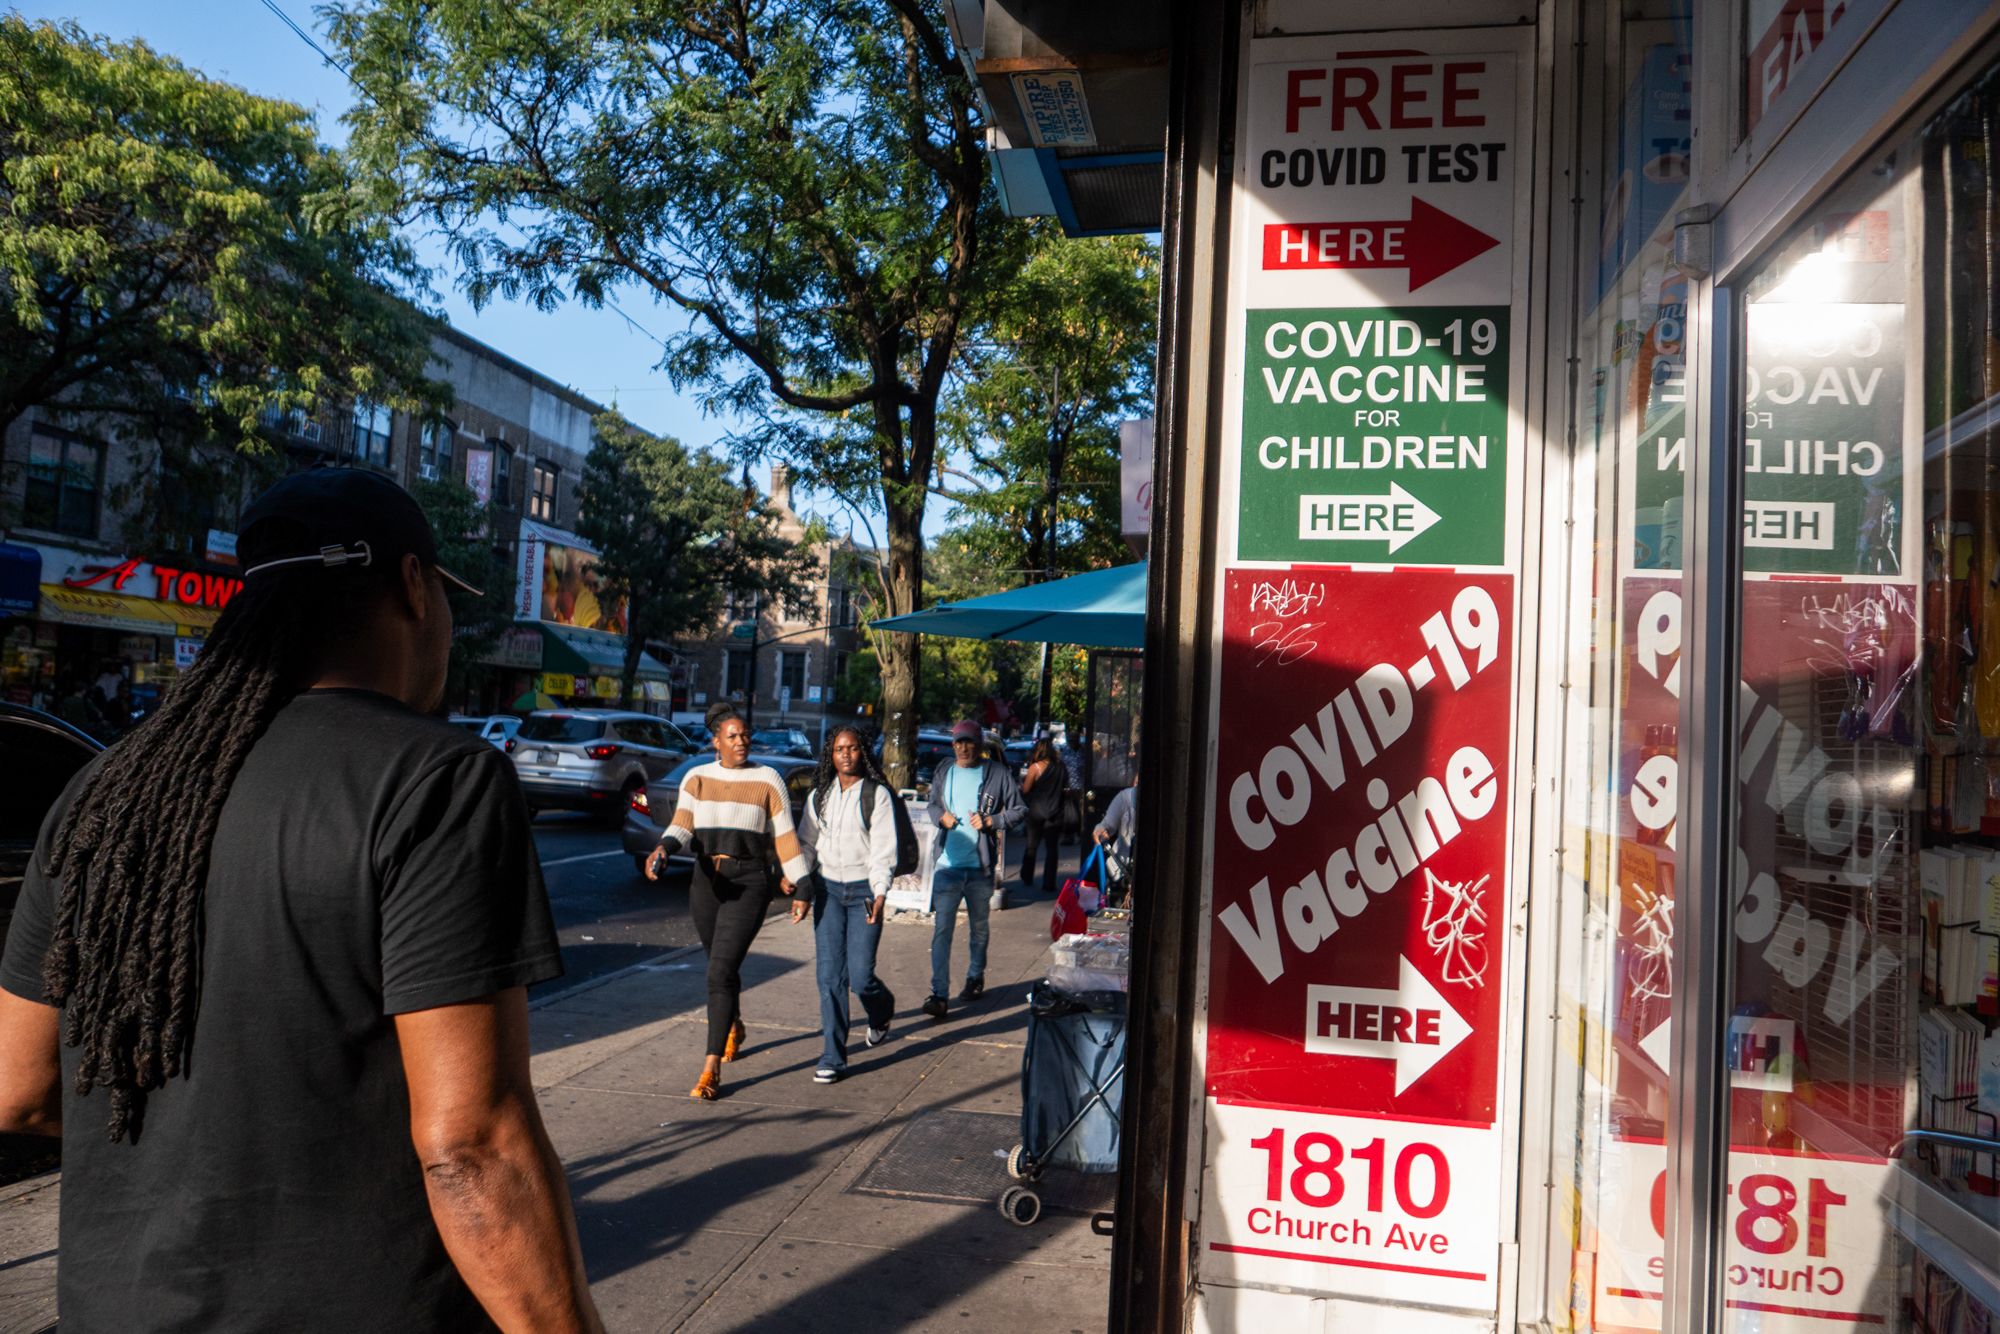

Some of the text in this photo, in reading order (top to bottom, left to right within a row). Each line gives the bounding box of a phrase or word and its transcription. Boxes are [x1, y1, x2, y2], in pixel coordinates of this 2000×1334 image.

[1286, 62, 1486, 133] FREE
[1260, 143, 1506, 188] COVID TEST
[1279, 227, 1405, 263] HERE
[1264, 318, 1497, 359] COVID-19
[1262, 365, 1487, 404] VACCINE
[1354, 410, 1400, 427] FOR
[1258, 435, 1487, 470] CHILDREN
[1311, 503, 1415, 531] HERE
[153, 565, 244, 608] TOW
[1229, 585, 1500, 851] COVID-19
[1218, 746, 1498, 985] Vaccine
[1317, 1001, 1441, 1045] HERE
[1250, 1127, 1451, 1219] 1810
[1247, 1206, 1449, 1255] Church Ave
